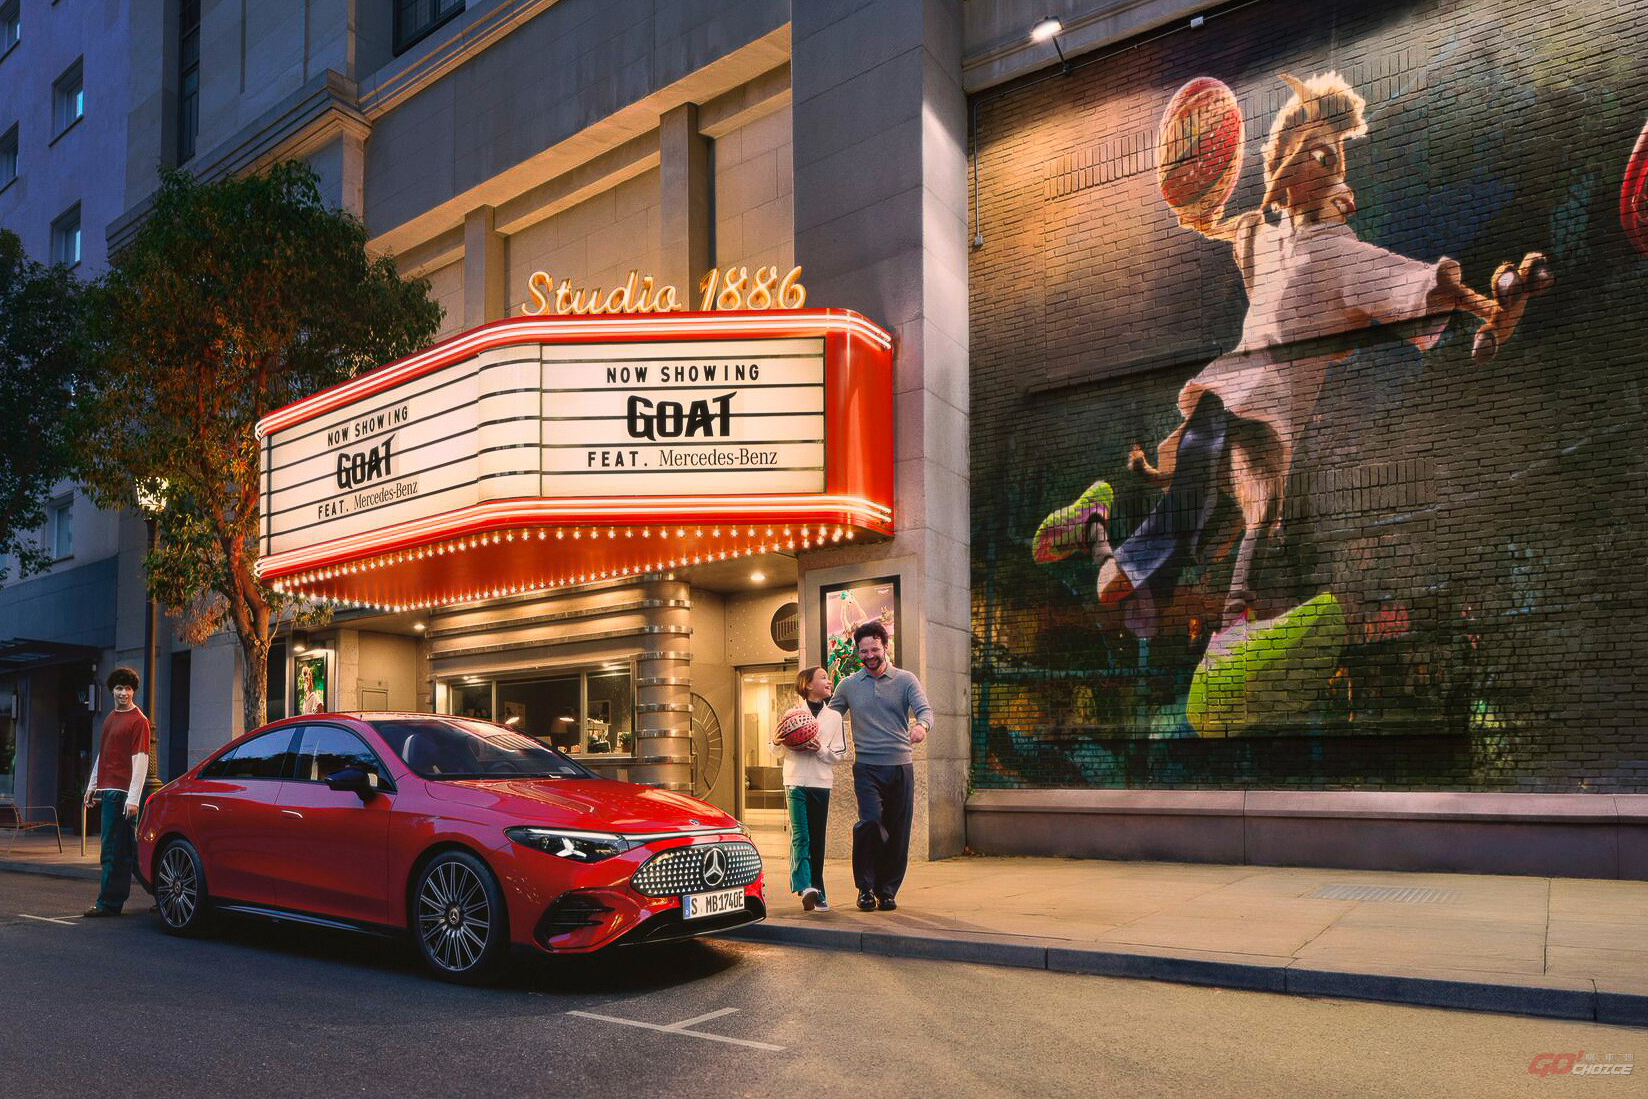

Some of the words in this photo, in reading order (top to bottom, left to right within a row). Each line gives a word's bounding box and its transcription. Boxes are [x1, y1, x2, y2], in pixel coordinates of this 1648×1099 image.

[521, 269, 682, 316] Studio
[699, 265, 807, 311] 1886
[607, 367, 648, 384] NOW
[660, 364, 760, 383] SHOWING
[327, 426, 349, 447] NOW
[354, 405, 408, 438] SHOWING
[627, 391, 738, 441] GOAT
[336, 433, 396, 489] GOAT
[587, 450, 648, 467] FEAT.
[659, 448, 778, 467] Mercedes-Benz
[318, 500, 349, 519] FEAT.
[354, 481, 418, 510] Mercedes-Benz
[690, 896, 698, 915] S
